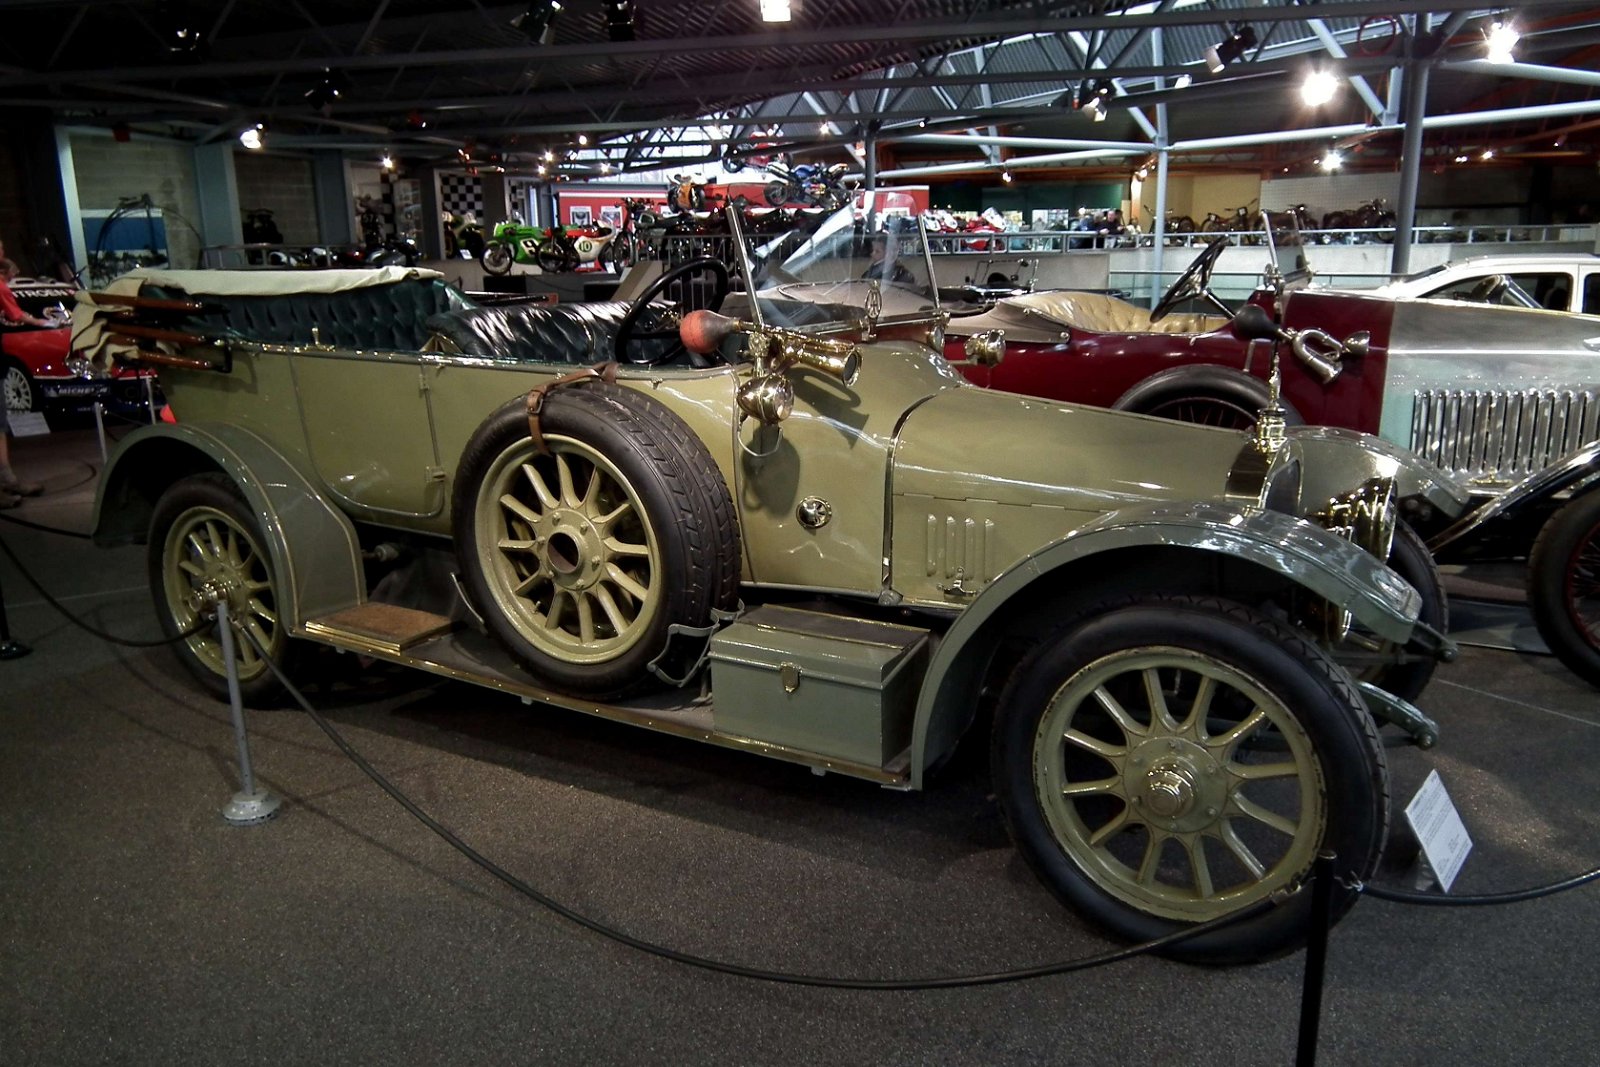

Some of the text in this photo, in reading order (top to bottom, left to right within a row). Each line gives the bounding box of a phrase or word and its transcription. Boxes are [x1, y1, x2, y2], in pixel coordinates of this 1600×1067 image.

[580, 241, 591, 252] 10
[11, 289, 68, 298] ITROEN
[58, 386, 108, 394] MICHELN
